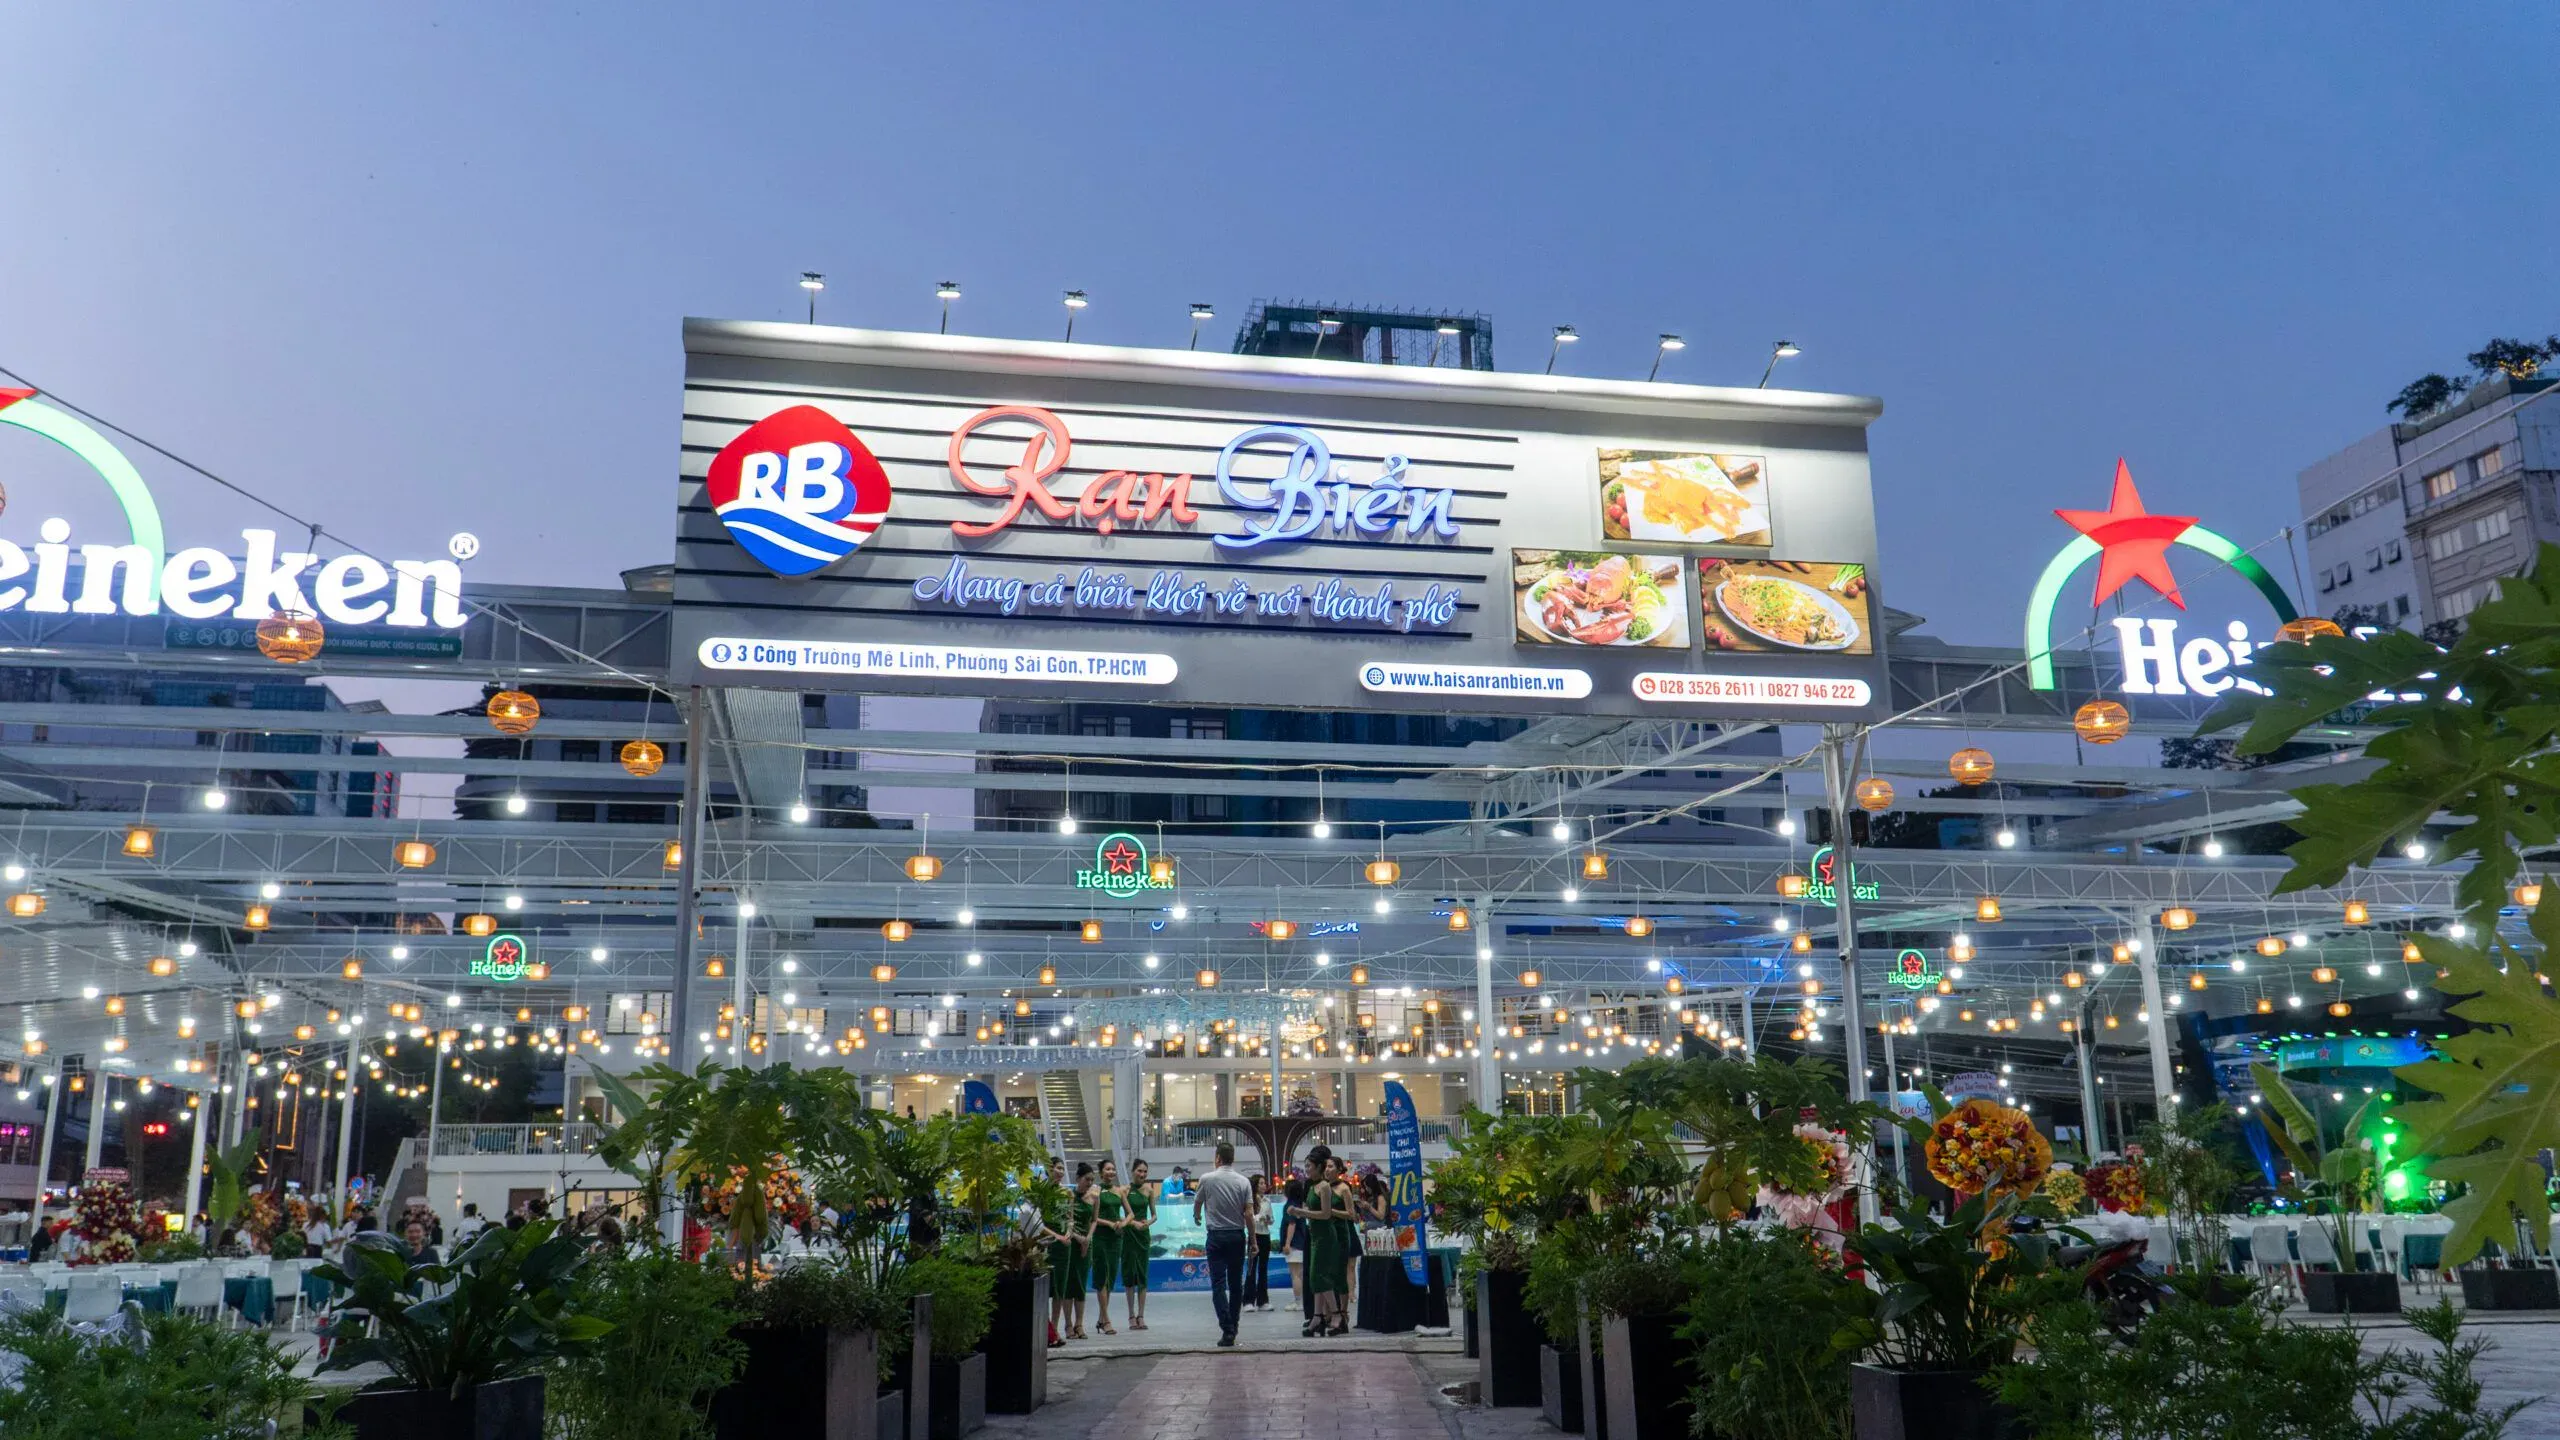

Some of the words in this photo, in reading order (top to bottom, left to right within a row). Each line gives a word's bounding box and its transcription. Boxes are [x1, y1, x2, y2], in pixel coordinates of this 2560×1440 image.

[738, 441, 857, 523] RB
[948, 405, 1198, 538] Rạn
[1212, 424, 1459, 549] Biển
[912, 554, 1024, 616] Mang
[1027, 573, 1066, 606] cả
[1073, 567, 1136, 610] biển
[1145, 570, 1207, 615] khơi
[1214, 578, 1250, 614] về
[1256, 585, 1303, 616] nơi
[1310, 577, 1395, 625] thành
[1401, 583, 1461, 634] phố
[737, 645, 748, 662] 3
[753, 645, 796, 666] Công
[899, 651, 940, 671] Linh,
[1087, 658, 1147, 676] TP.HCM
[1390, 671, 1565, 691] www.haisanranbien.vn
[1660, 680, 1684, 695] 028
[1688, 681, 1721, 696] 3526
[1725, 682, 1755, 697] 2611
[1767, 683, 1799, 698] 0827
[1804, 684, 1828, 699] 946
[1832, 685, 1856, 700] 222
[1797, 880, 1879, 900] Heinen
[470, 961, 534, 976] Heineke
